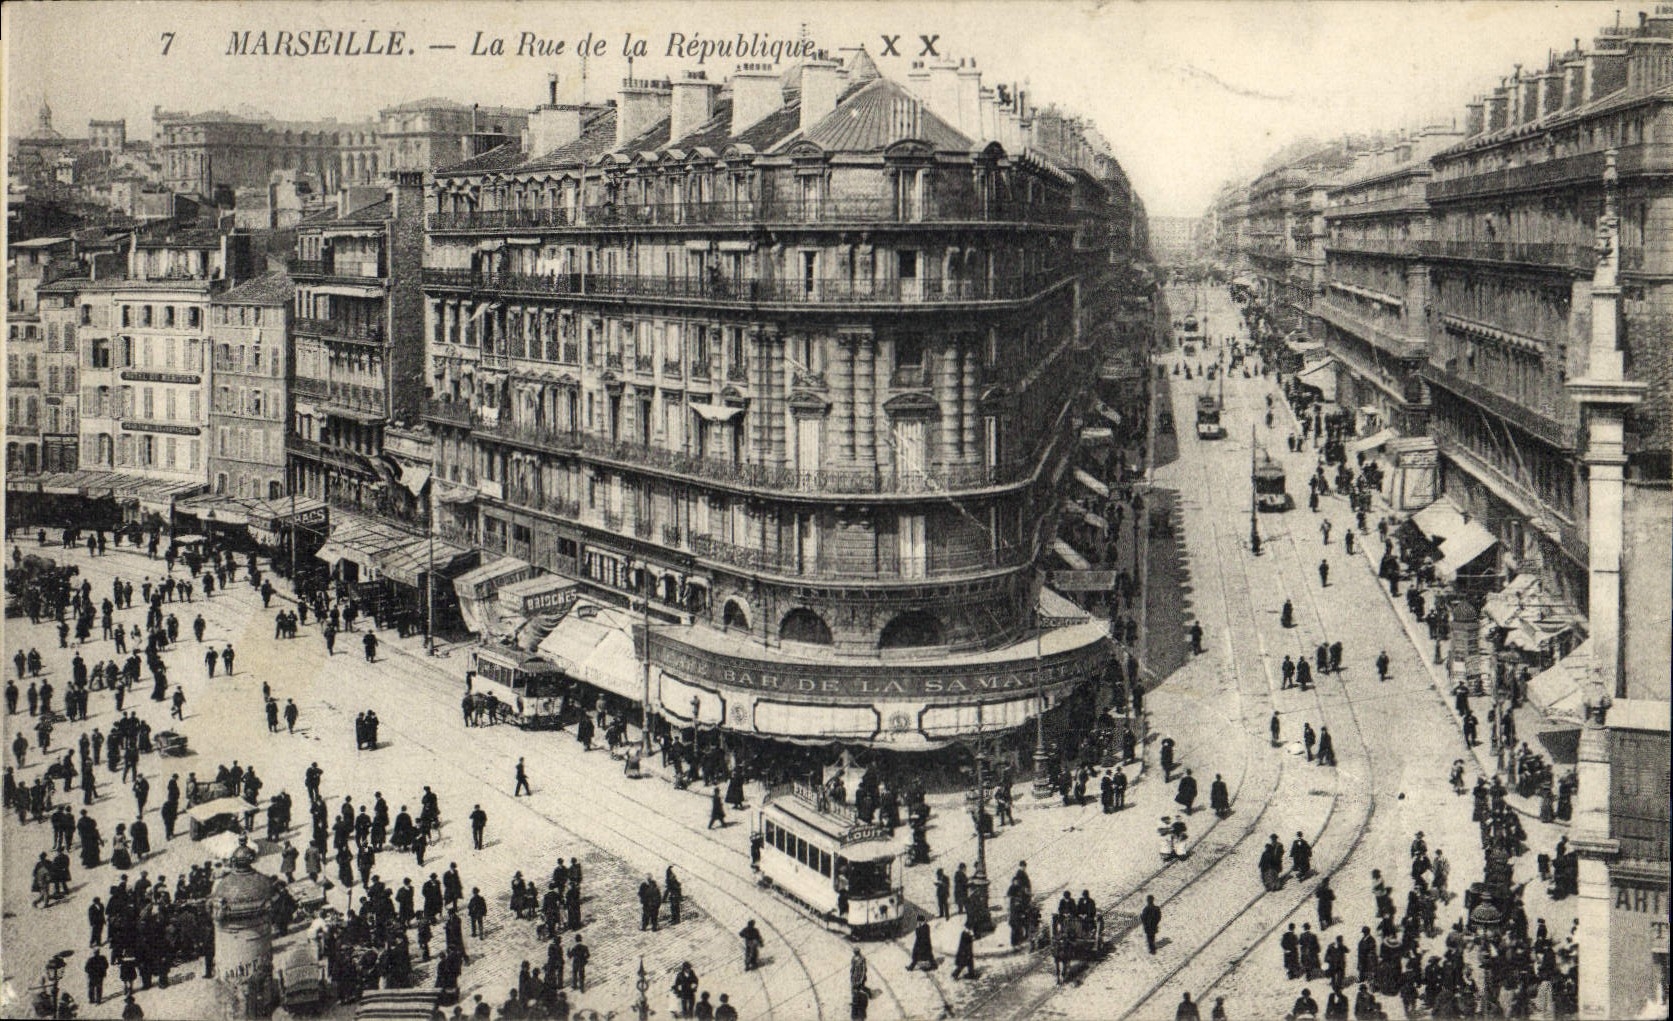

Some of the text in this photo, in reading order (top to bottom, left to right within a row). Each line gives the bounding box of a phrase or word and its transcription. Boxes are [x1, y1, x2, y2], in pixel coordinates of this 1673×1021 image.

[527, 589, 578, 610] BRIOCHES
[723, 671, 779, 688] BAR
[799, 678, 841, 692] DE
[862, 680, 906, 693] LA
